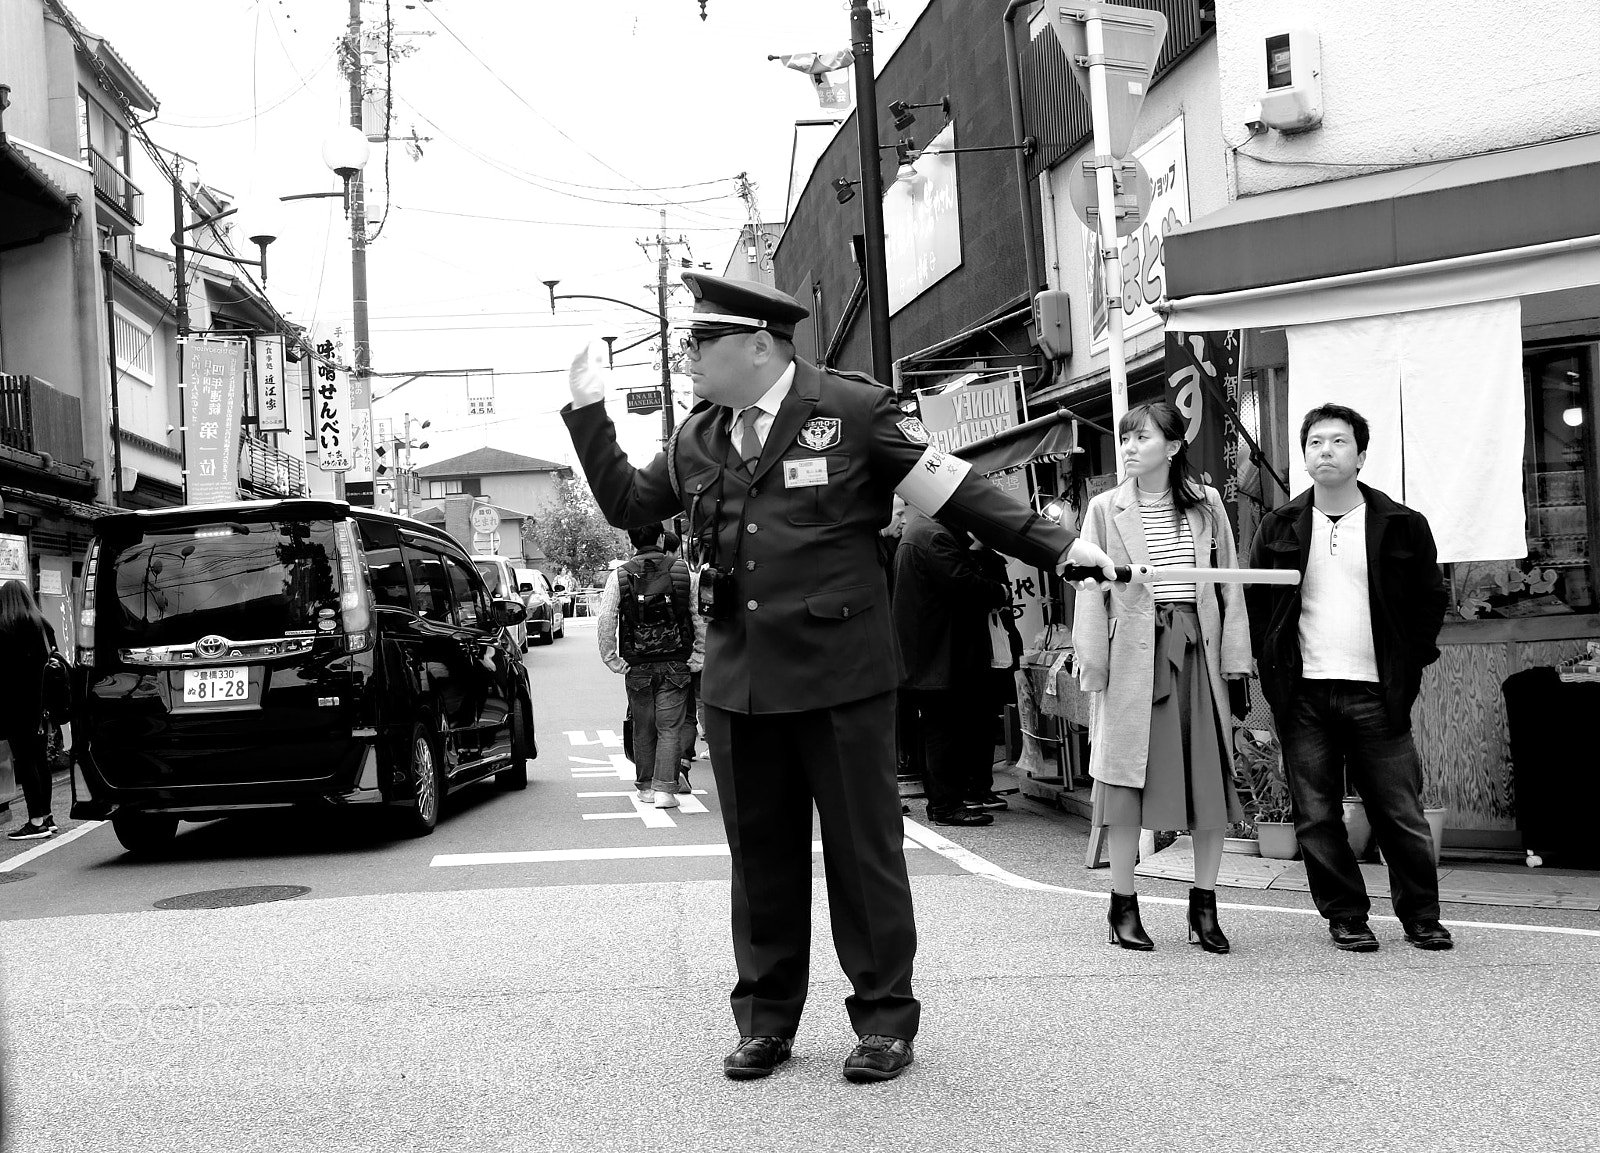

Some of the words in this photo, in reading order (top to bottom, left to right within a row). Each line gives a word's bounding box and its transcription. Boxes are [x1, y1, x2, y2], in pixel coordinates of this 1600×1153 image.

[631, 392, 657, 400] INARI
[474, 516, 498, 527] とまれ
[218, 669, 234, 679] 330
[197, 680, 245, 699] 81-28
